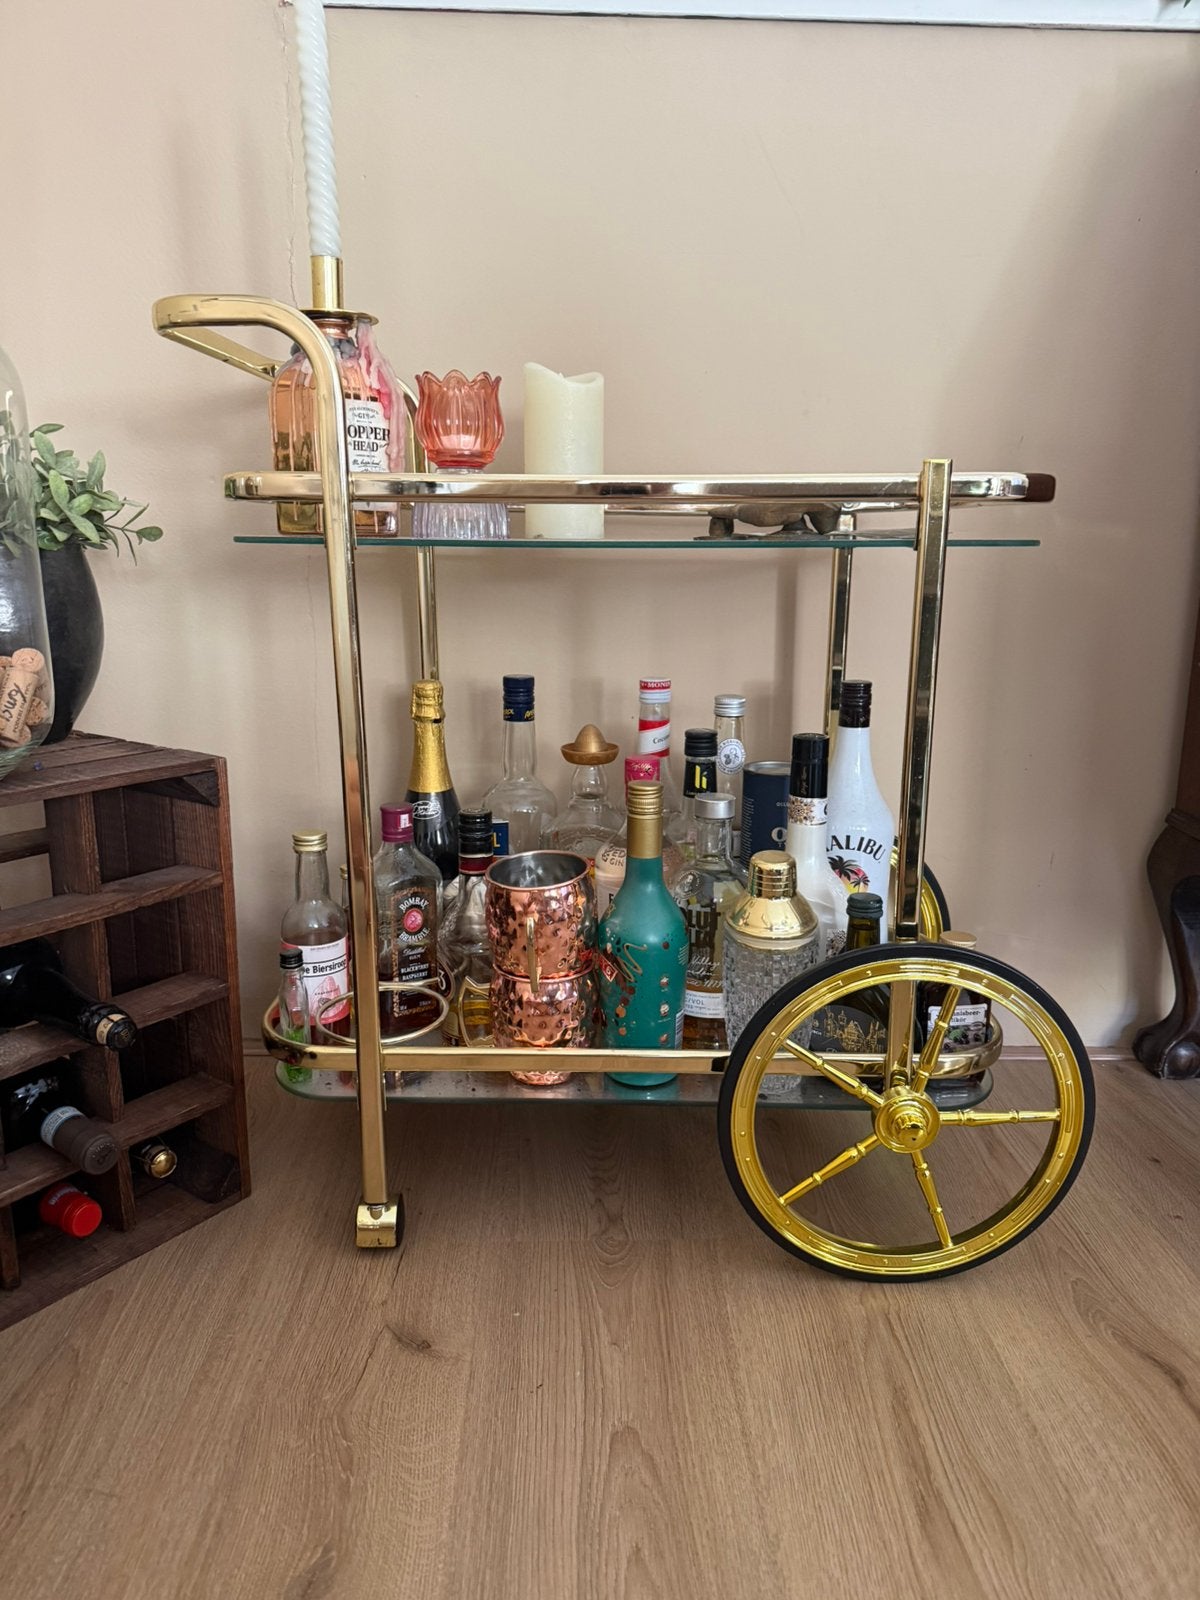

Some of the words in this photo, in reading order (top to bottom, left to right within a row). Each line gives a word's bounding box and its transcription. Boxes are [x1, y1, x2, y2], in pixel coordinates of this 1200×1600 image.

[352, 440, 379, 452] HEAD
[826, 834, 886, 861] ALIBU
[399, 897, 429, 913] BOMBAY
